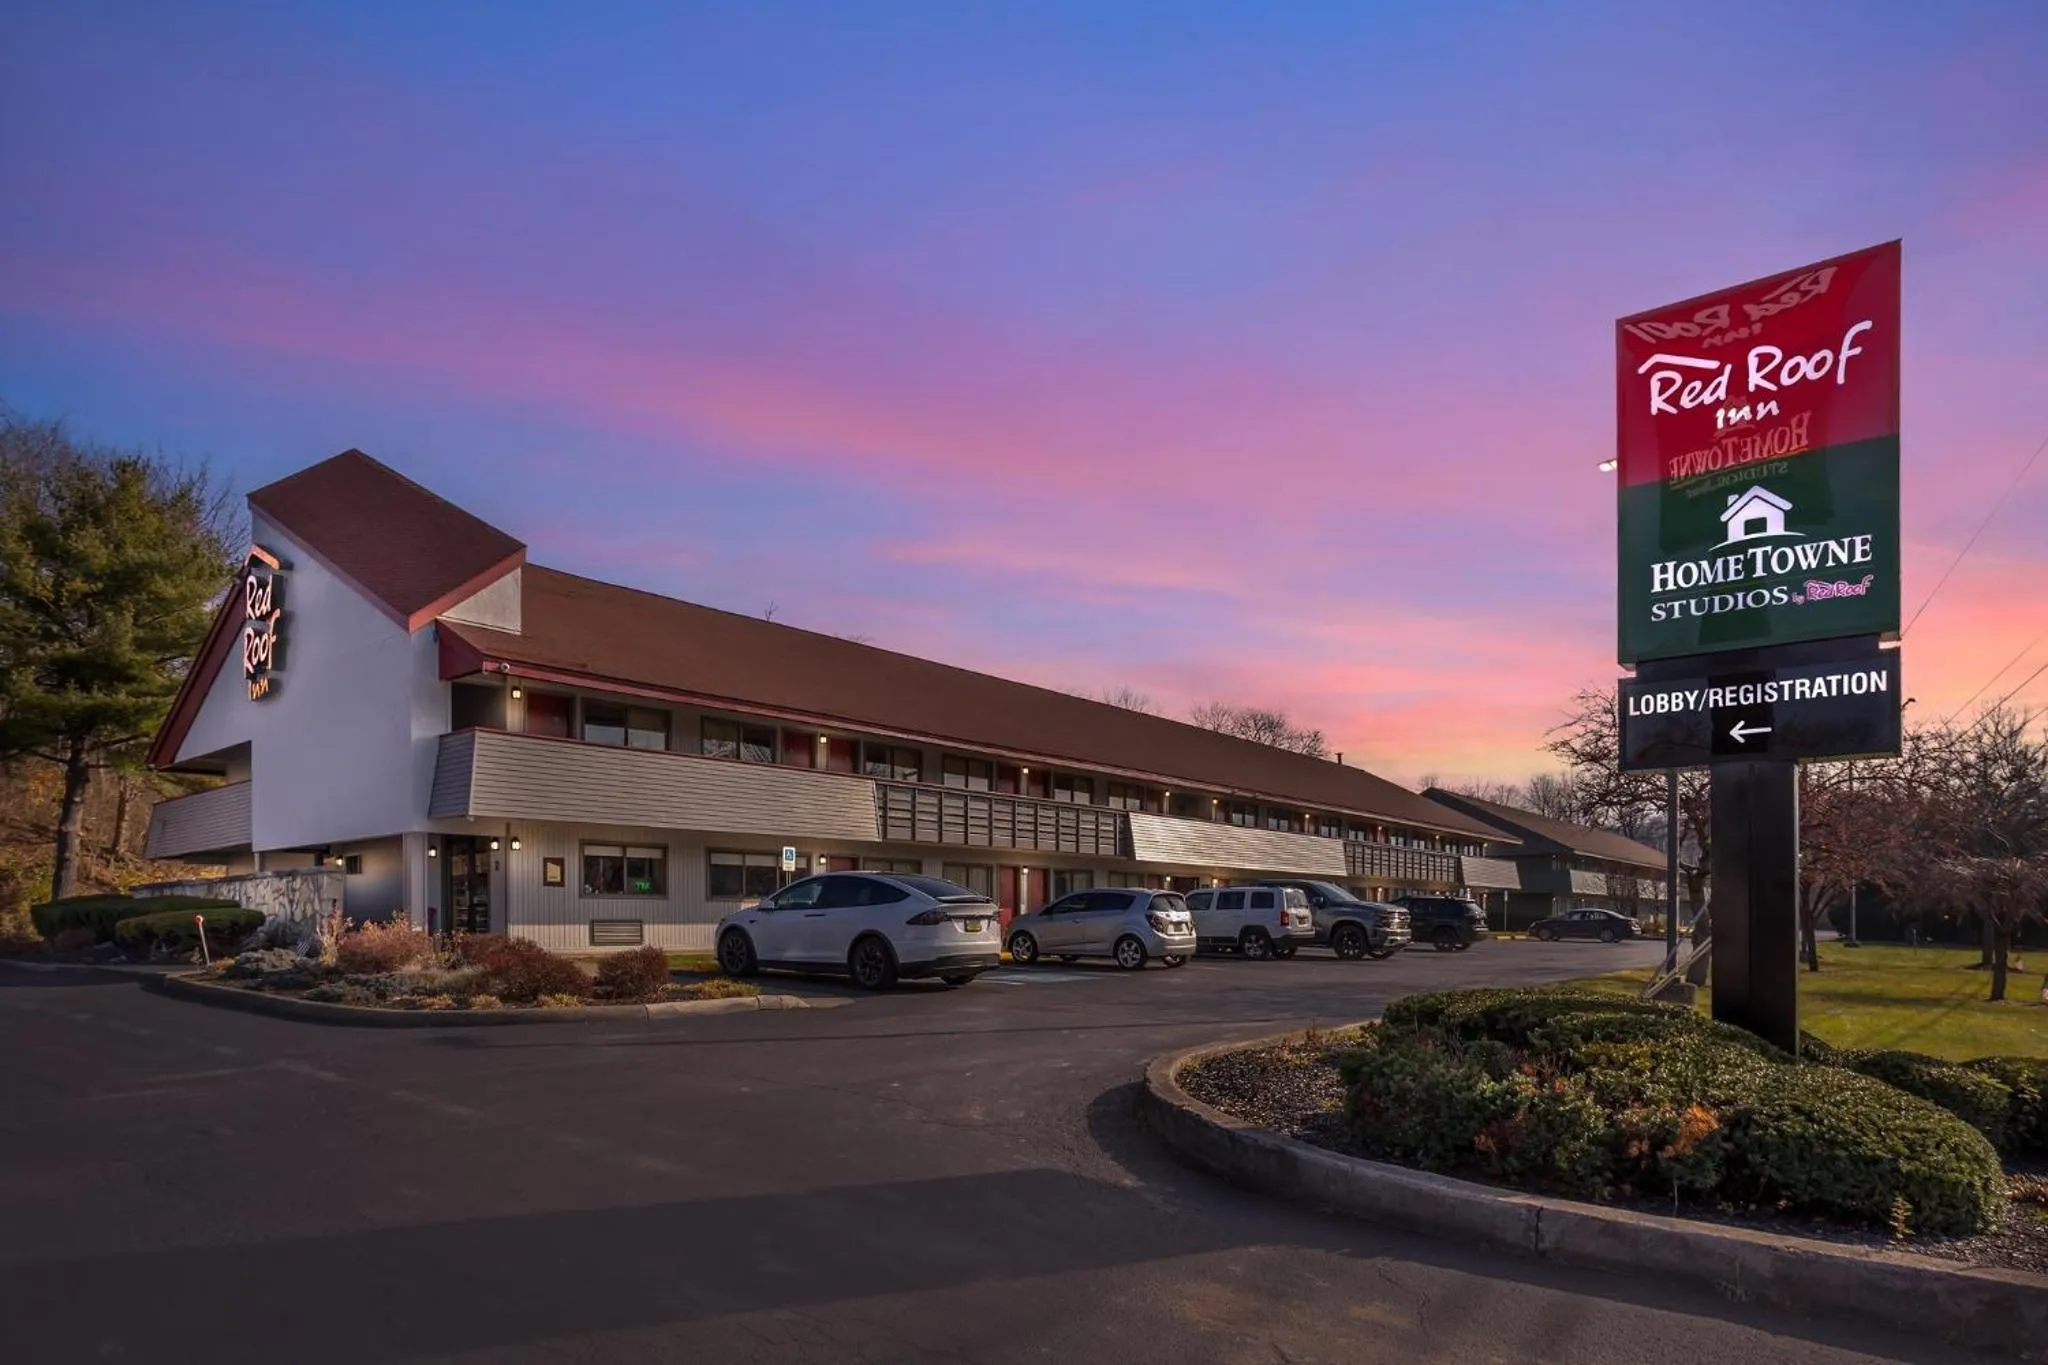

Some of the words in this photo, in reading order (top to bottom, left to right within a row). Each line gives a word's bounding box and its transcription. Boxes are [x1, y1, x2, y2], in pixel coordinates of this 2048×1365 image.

[1650, 363, 1732, 415] Red
[1747, 320, 1873, 393] Roof
[246, 574, 273, 620] Red
[1651, 585, 1789, 622] STUDIOS
[1834, 574, 1874, 597] Roof
[243, 608, 281, 677] Roof
[1628, 670, 1888, 716] LOBBY/REGISTRATION
